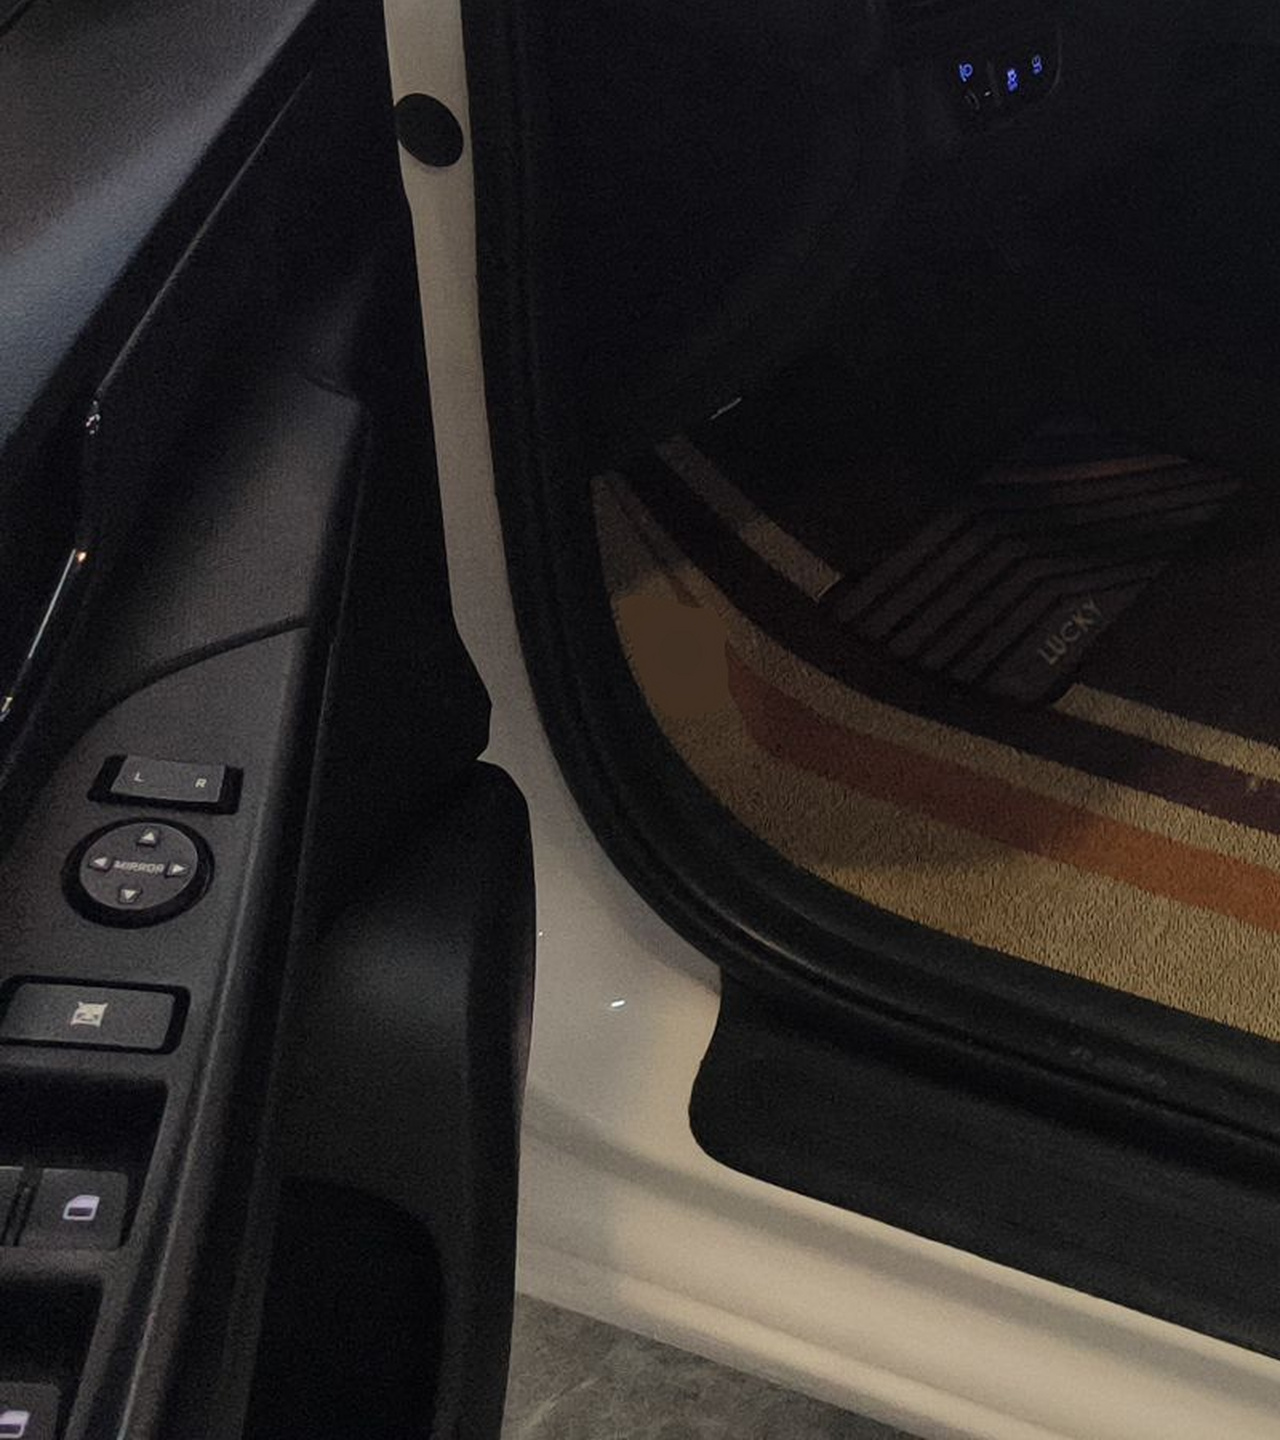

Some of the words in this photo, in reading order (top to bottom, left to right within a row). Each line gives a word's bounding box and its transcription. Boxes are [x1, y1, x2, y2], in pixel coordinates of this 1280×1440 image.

[1036, 597, 1106, 666] LUCKY
[133, 771, 145, 783] L
[195, 777, 207, 788] R
[113, 859, 165, 875] MIRROR
